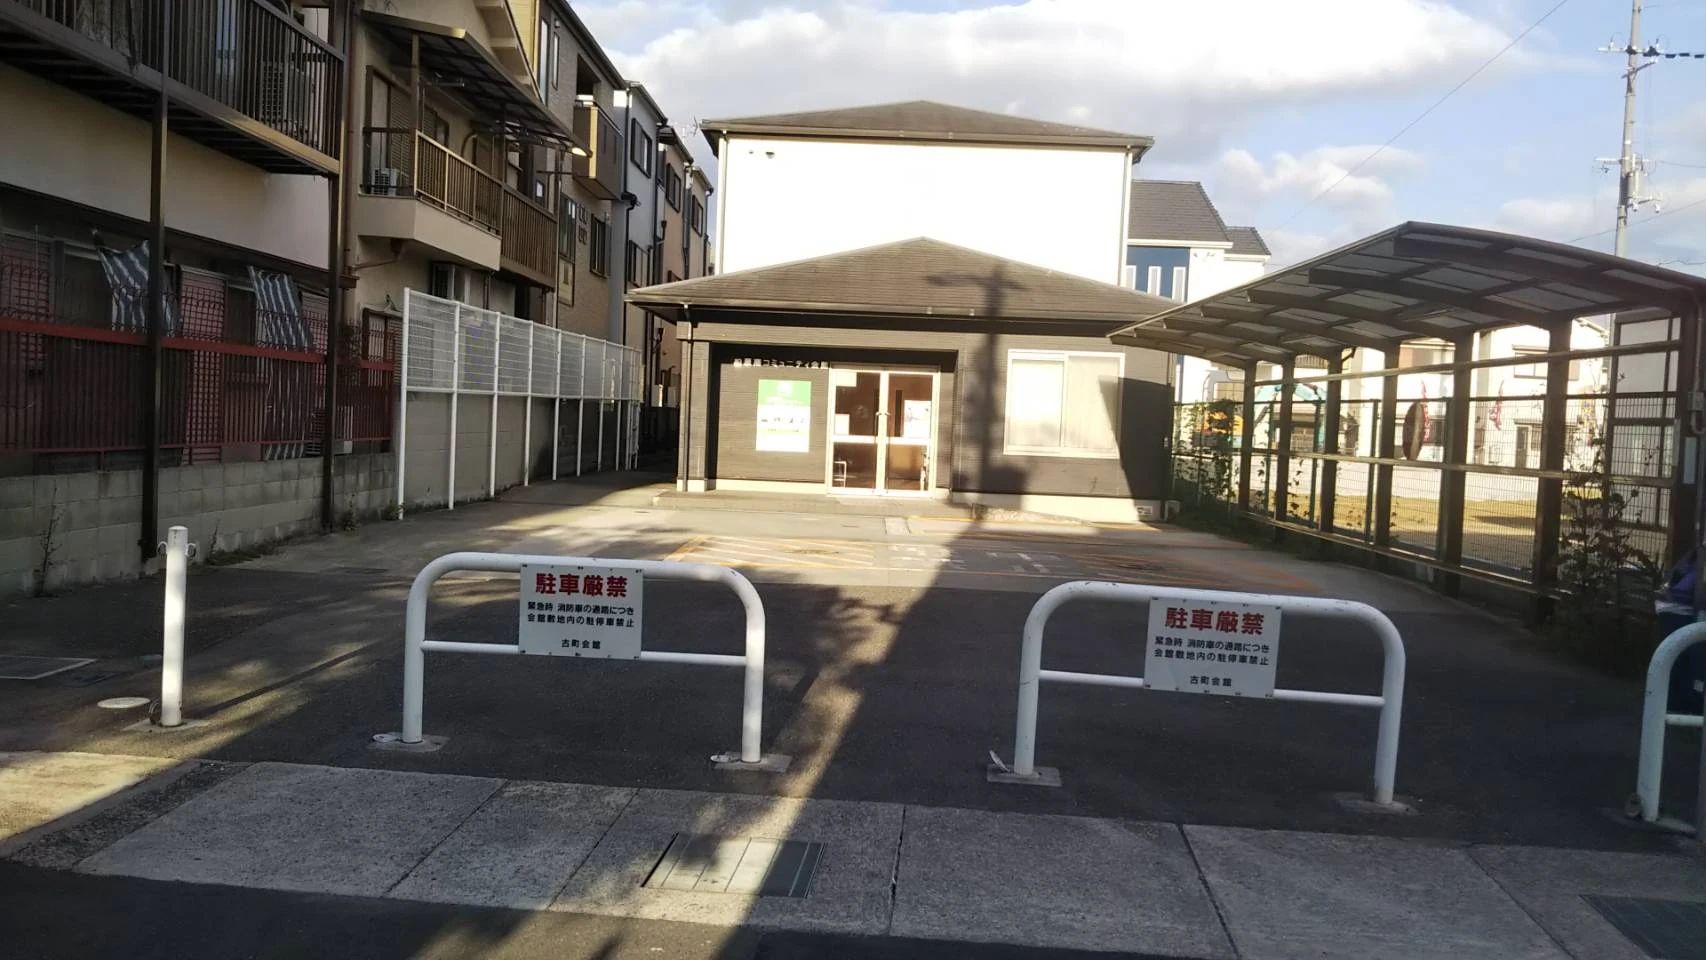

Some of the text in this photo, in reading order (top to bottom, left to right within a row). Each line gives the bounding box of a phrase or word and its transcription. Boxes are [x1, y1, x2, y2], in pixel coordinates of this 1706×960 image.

[535, 572, 628, 598] 駐車厳禁
[527, 601, 554, 611] 緊急時
[527, 613, 635, 628] 会館敷地内の駐停車禁止
[1164, 607, 1265, 636] 駐車厳禁
[561, 638, 601, 650] 古町会館
[1154, 636, 1183, 648] 緊急時
[1154, 648, 1270, 666] 会館敷地内の駐停車禁止
[1189, 675, 1233, 687] 古町会館
